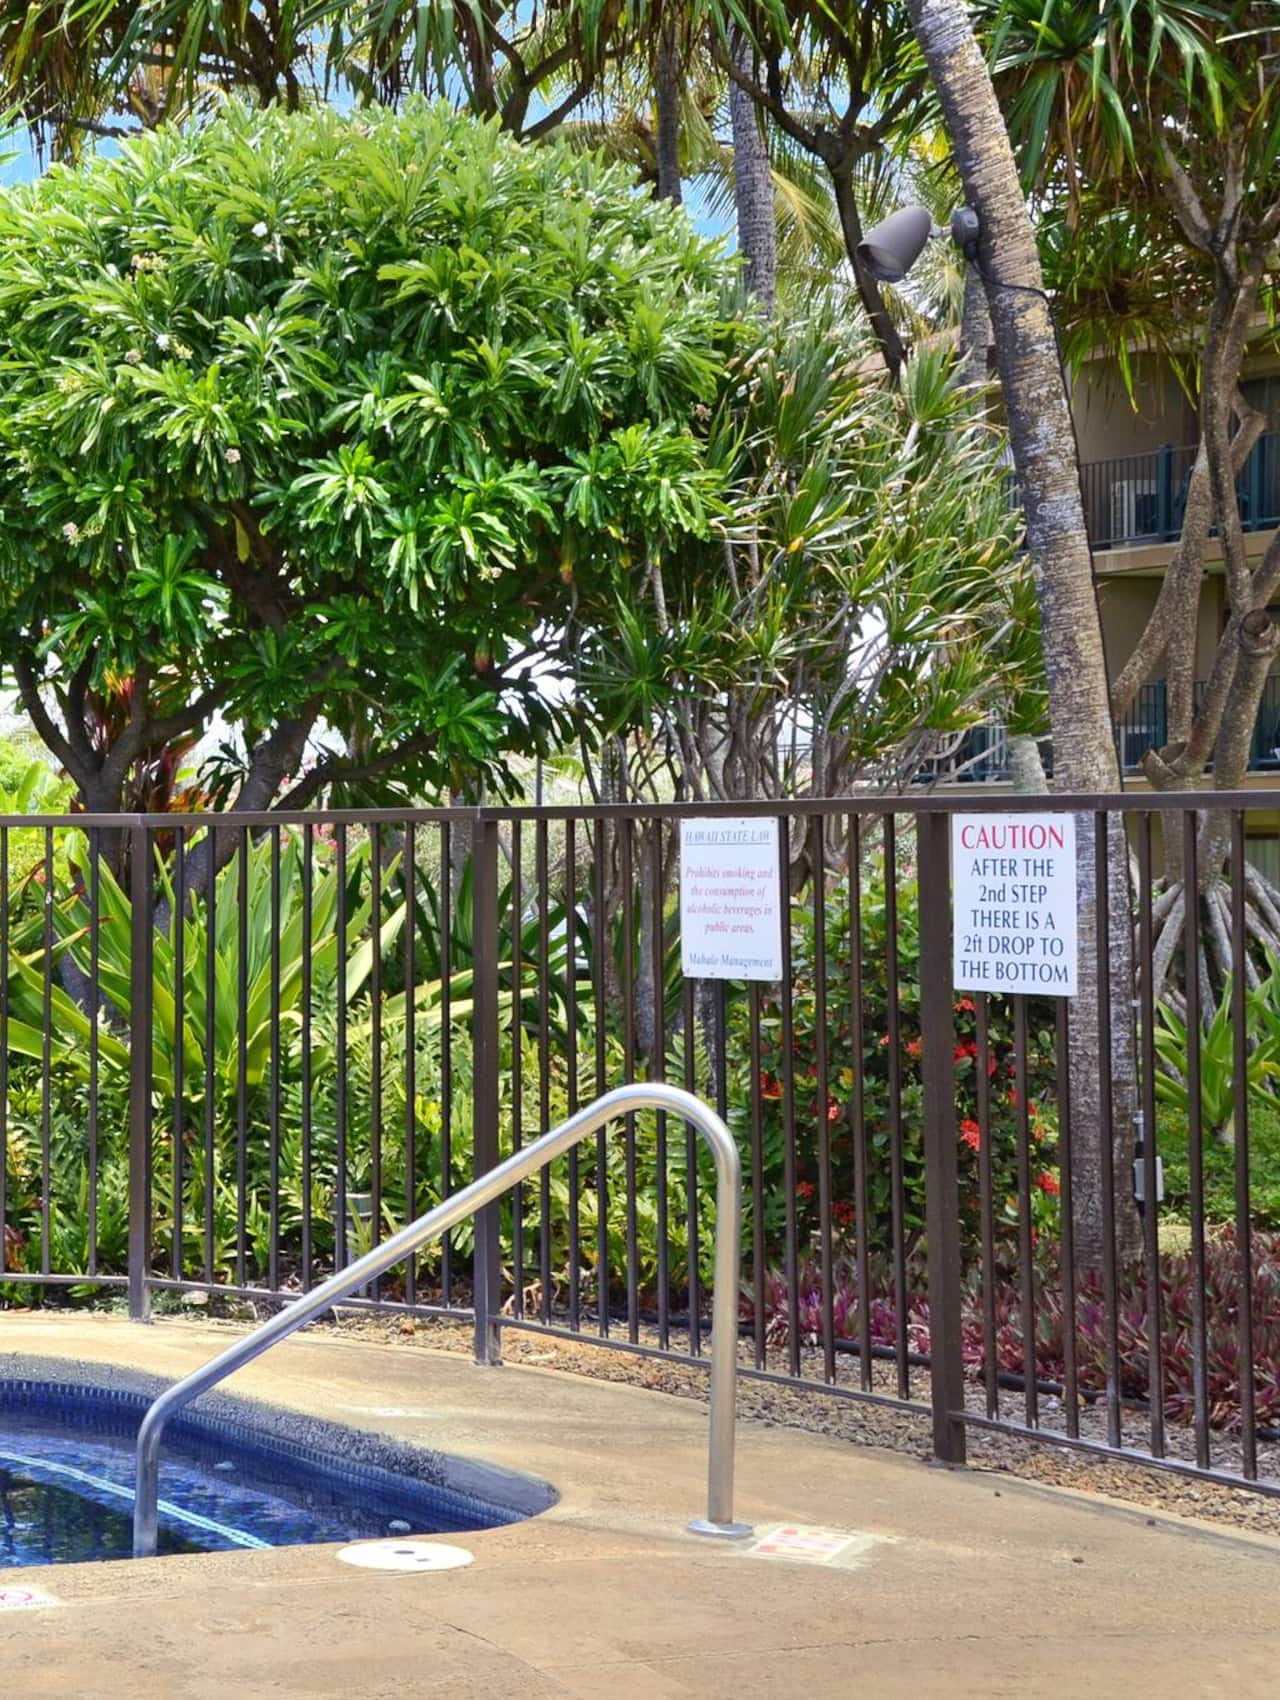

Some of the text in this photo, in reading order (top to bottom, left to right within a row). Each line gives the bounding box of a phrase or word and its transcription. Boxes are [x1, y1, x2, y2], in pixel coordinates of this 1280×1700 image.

[685, 830, 771, 842] HAWAII STATE LAW
[961, 824, 1064, 850] CAUTION
[685, 866, 773, 880] Prohibits smoking and
[971, 858, 1054, 878] AFTER THE
[691, 885, 767, 900] the consumption of
[979, 883, 1047, 903] 2nd STEP
[686, 902, 773, 917] alcoholic beverages in
[704, 922, 730, 935] public
[971, 909, 1056, 930] THERE IS A
[963, 934, 1064, 956] 2ft DROP TO
[689, 952, 773, 969] Mahalo Management
[960, 960, 1069, 983] THE BOTTOM
